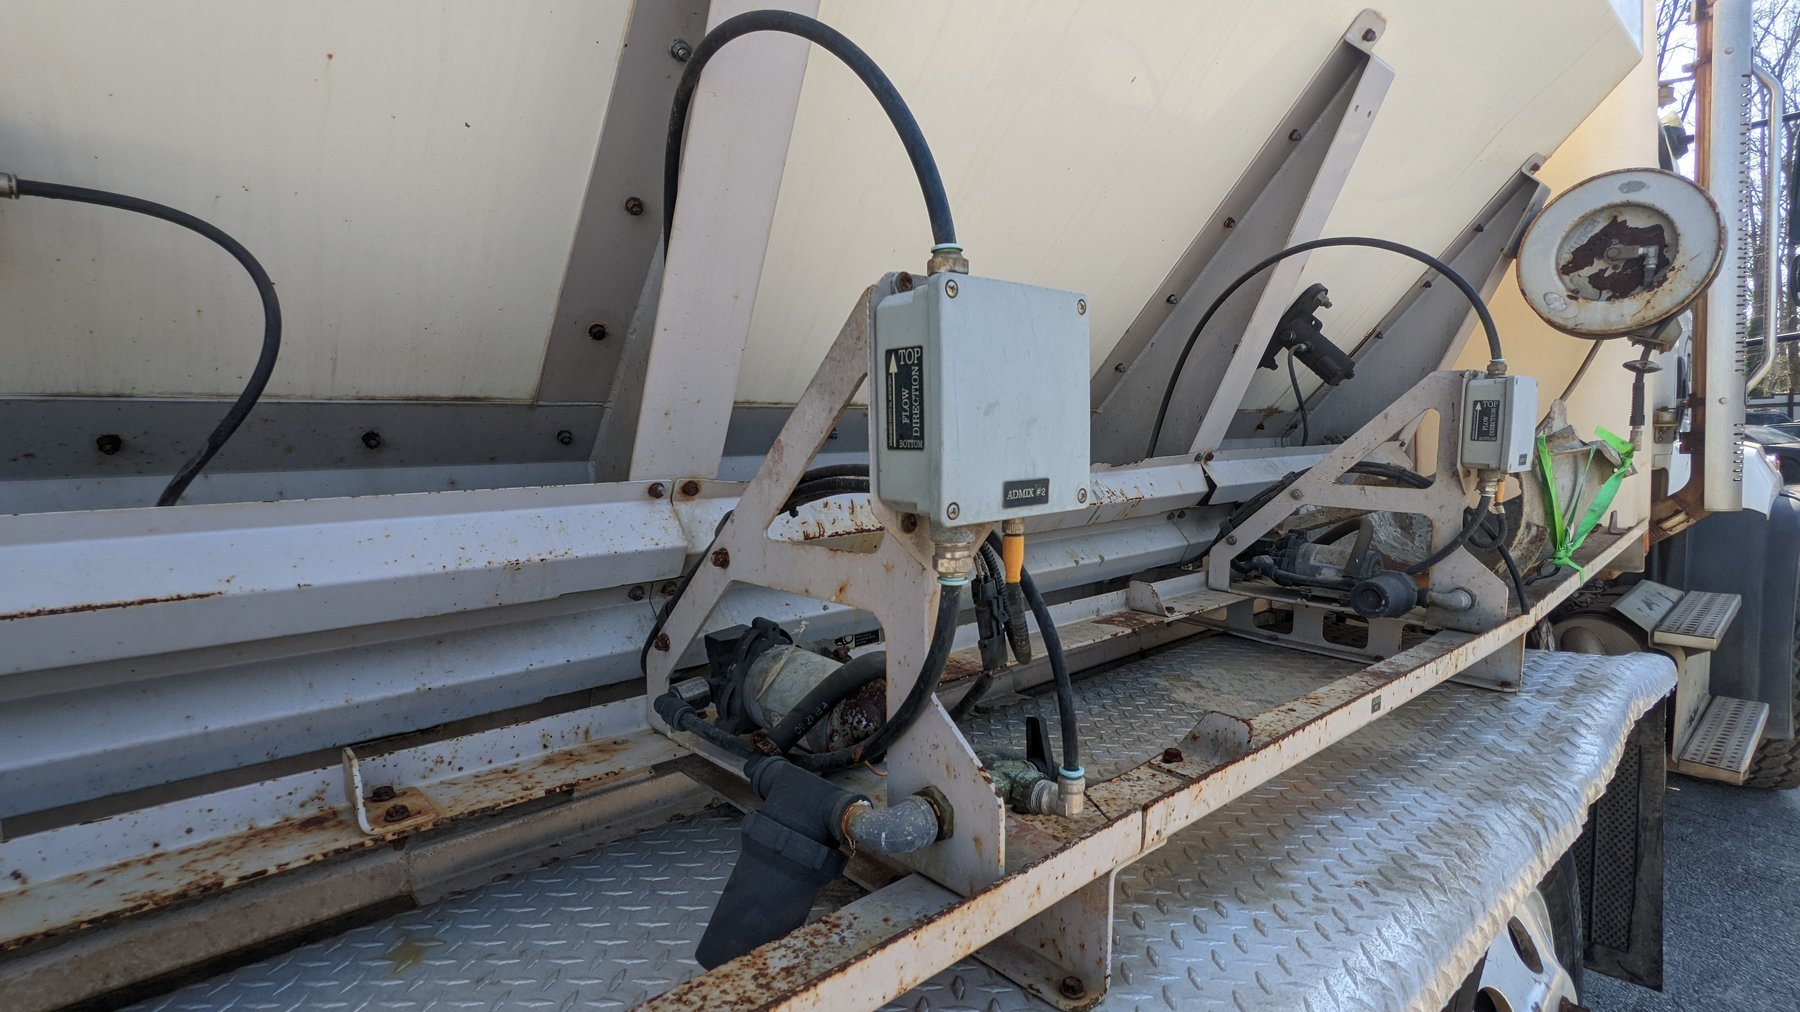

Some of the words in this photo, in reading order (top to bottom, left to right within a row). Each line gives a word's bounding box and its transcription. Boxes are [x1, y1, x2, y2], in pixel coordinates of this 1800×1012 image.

[899, 348, 921, 365] TOP
[902, 388, 910, 423] FLOW
[912, 366, 920, 436] DIRECTION
[899, 439, 924, 449] BOTTOM
[1006, 488, 1035, 500] ADMIX
